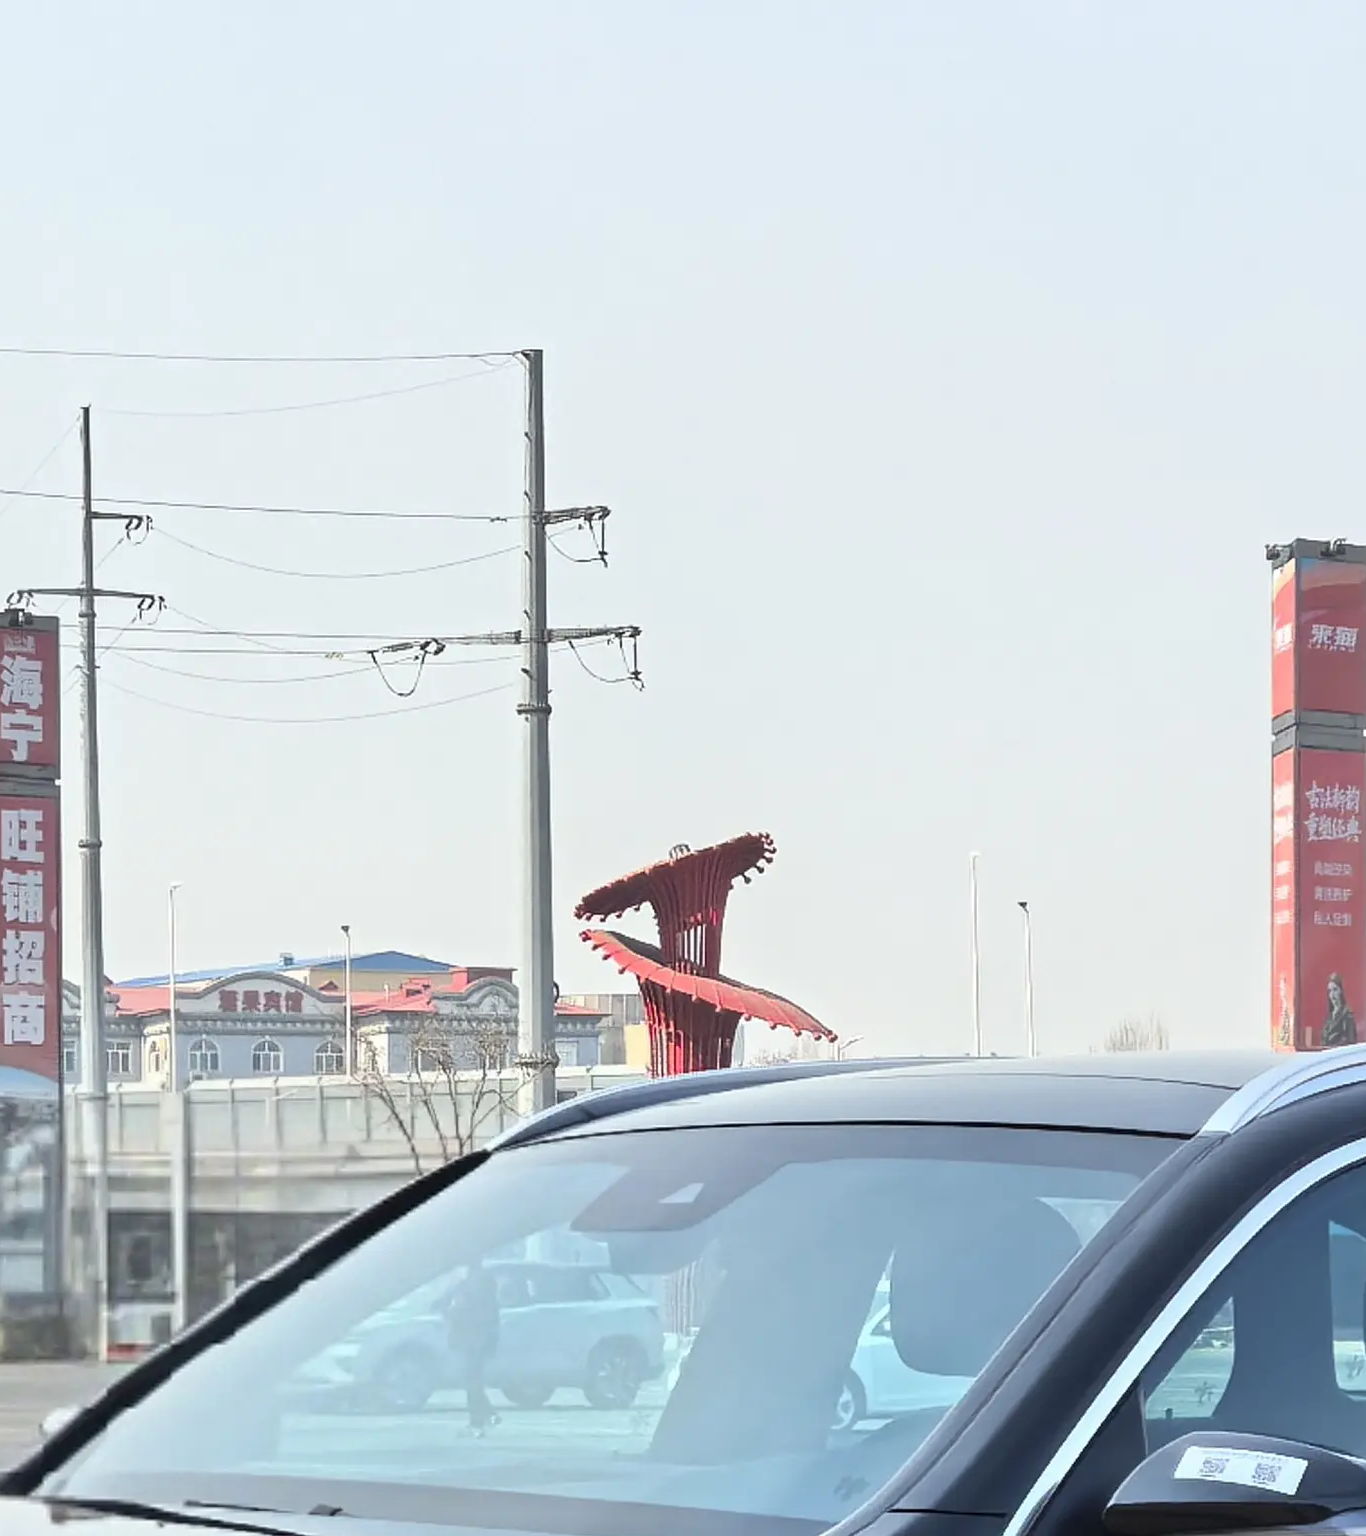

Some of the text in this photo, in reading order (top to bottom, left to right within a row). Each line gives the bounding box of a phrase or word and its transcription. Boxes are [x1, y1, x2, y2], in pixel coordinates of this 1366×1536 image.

[0, 654, 44, 762] 海宁
[0, 809, 46, 1046] 旺铺招商
